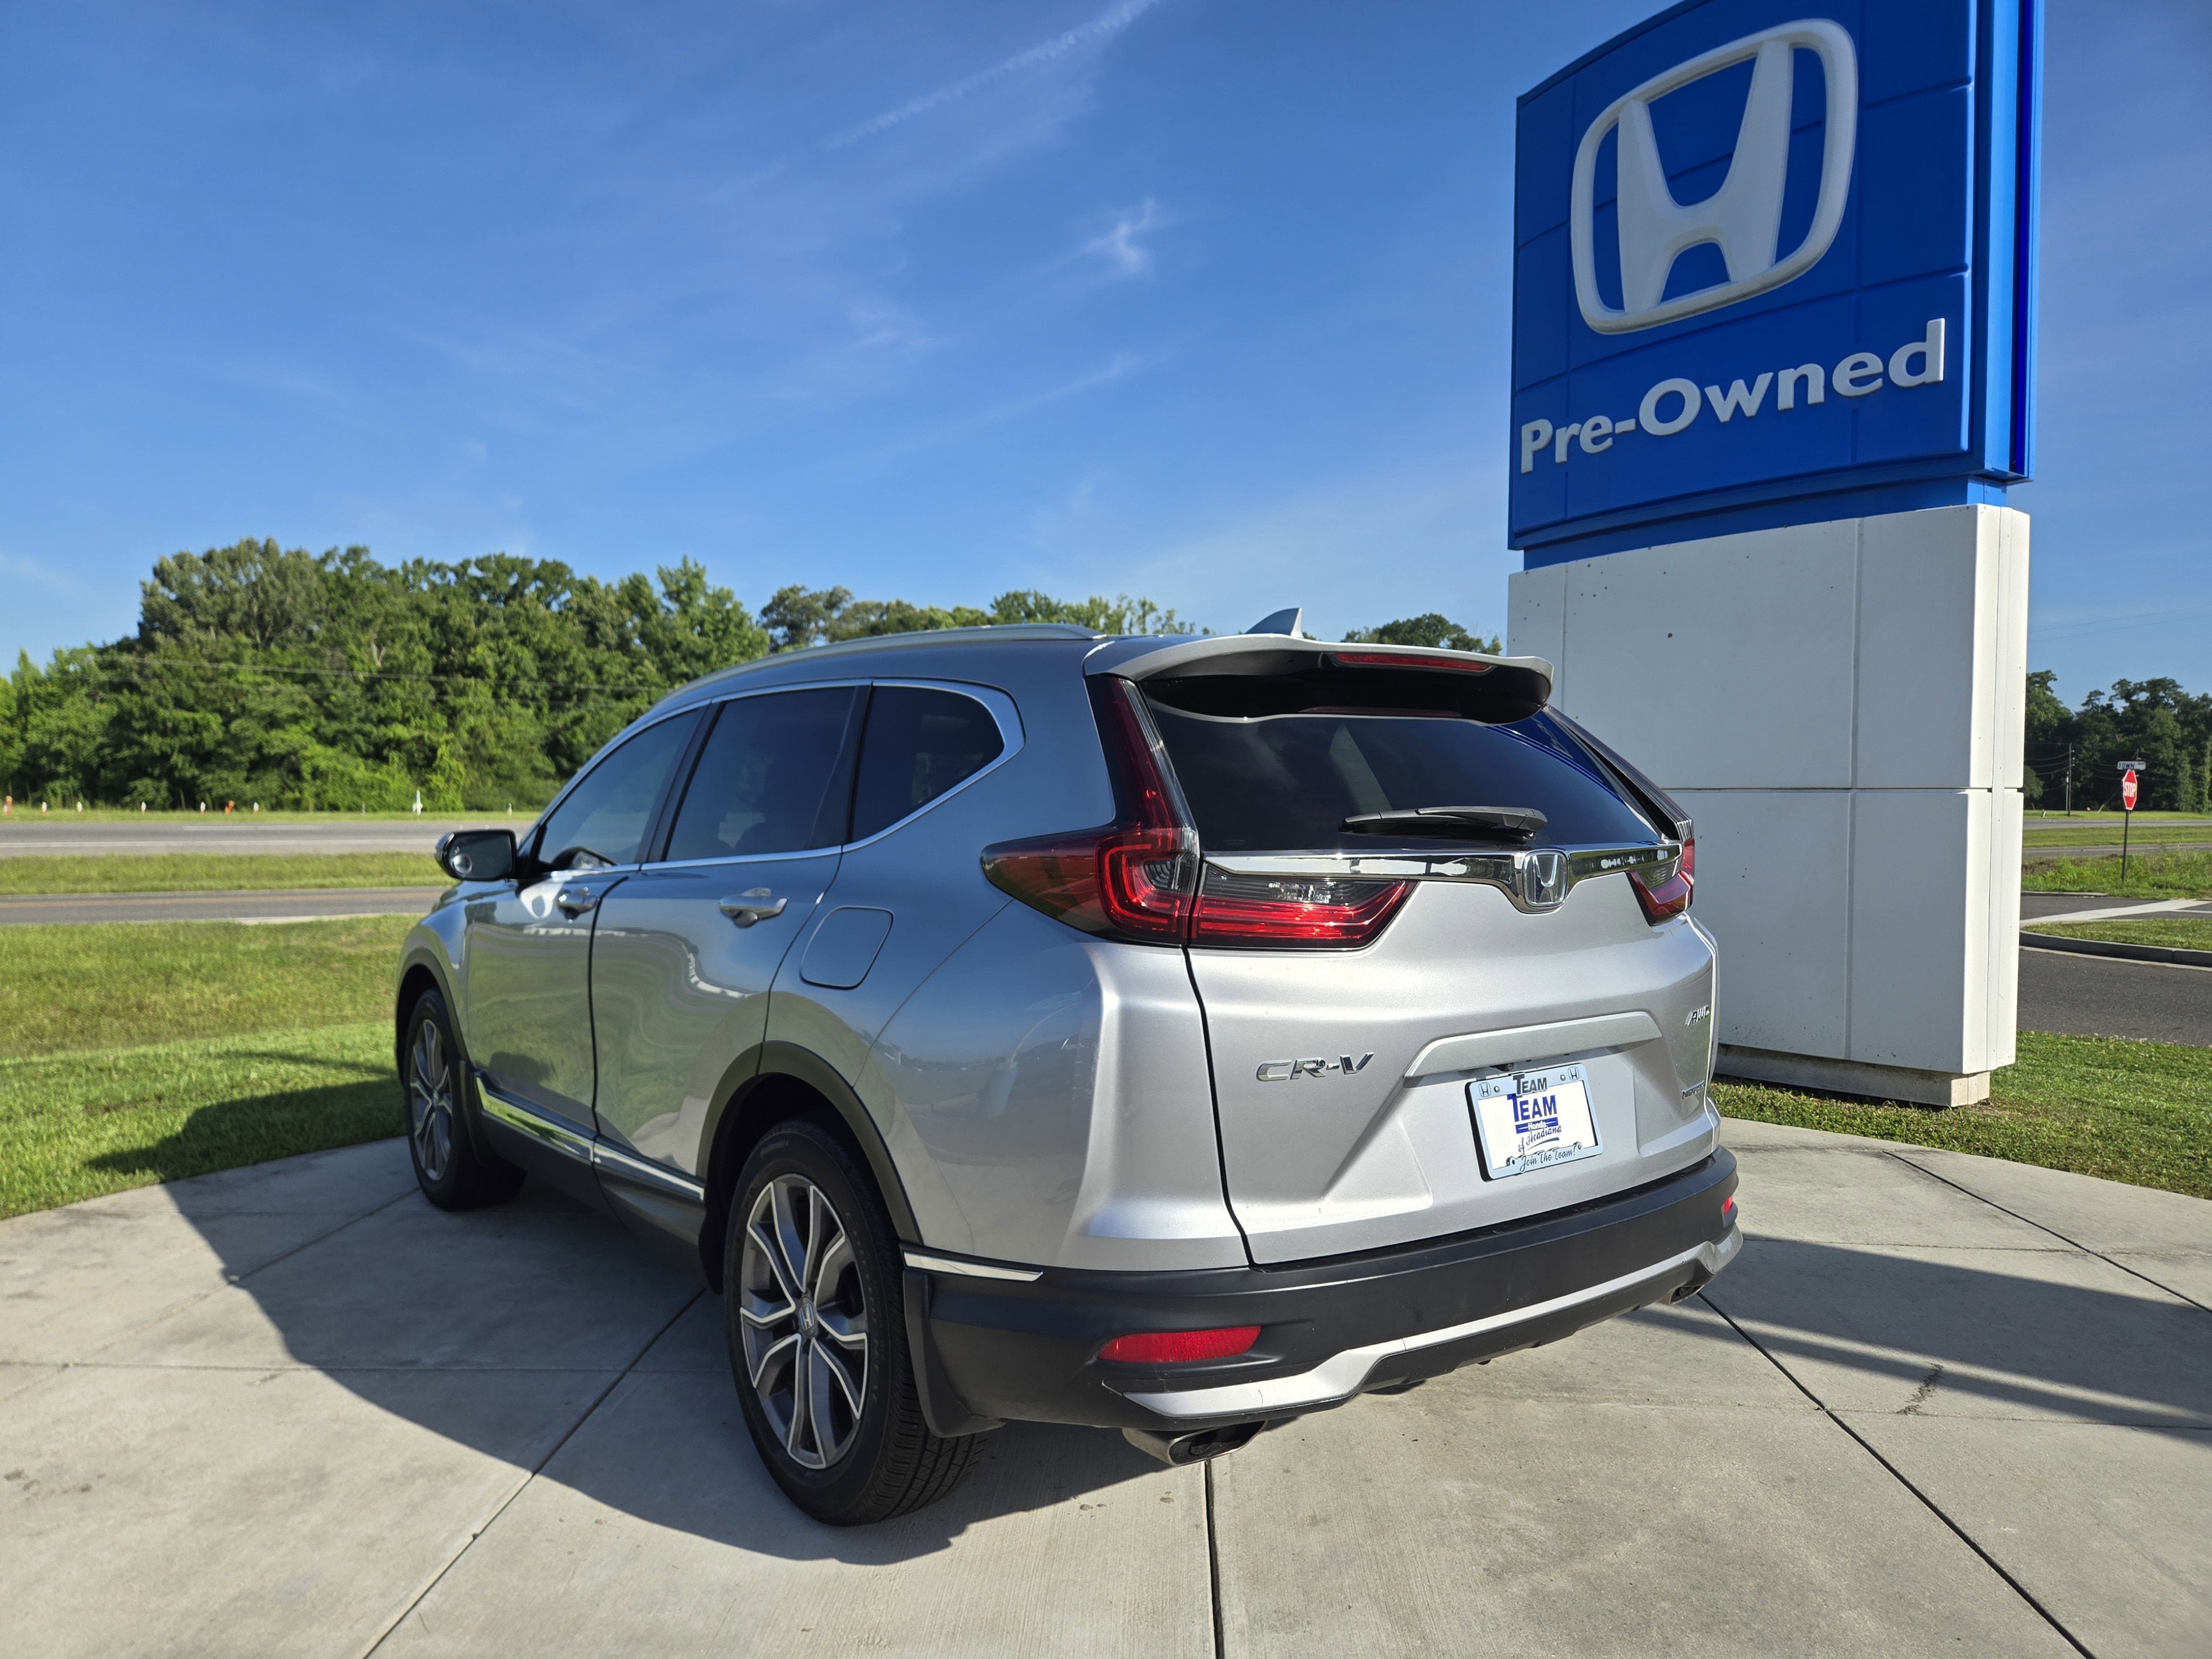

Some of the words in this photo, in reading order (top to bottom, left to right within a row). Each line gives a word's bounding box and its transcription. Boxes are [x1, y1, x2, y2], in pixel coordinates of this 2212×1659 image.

[1520, 317, 1946, 474] Pre-Owned
[2124, 781, 2136, 797] STOP
[1256, 1051, 1375, 1081] CR-V
[1527, 1120, 1547, 1130] Honda
[1518, 1137, 1525, 1155] of
[1526, 1125, 1562, 1146] Acadiana
[1520, 1155, 1538, 1172] Join
[1537, 1151, 1552, 1164] The
[1552, 1145, 1576, 1160] Team!
